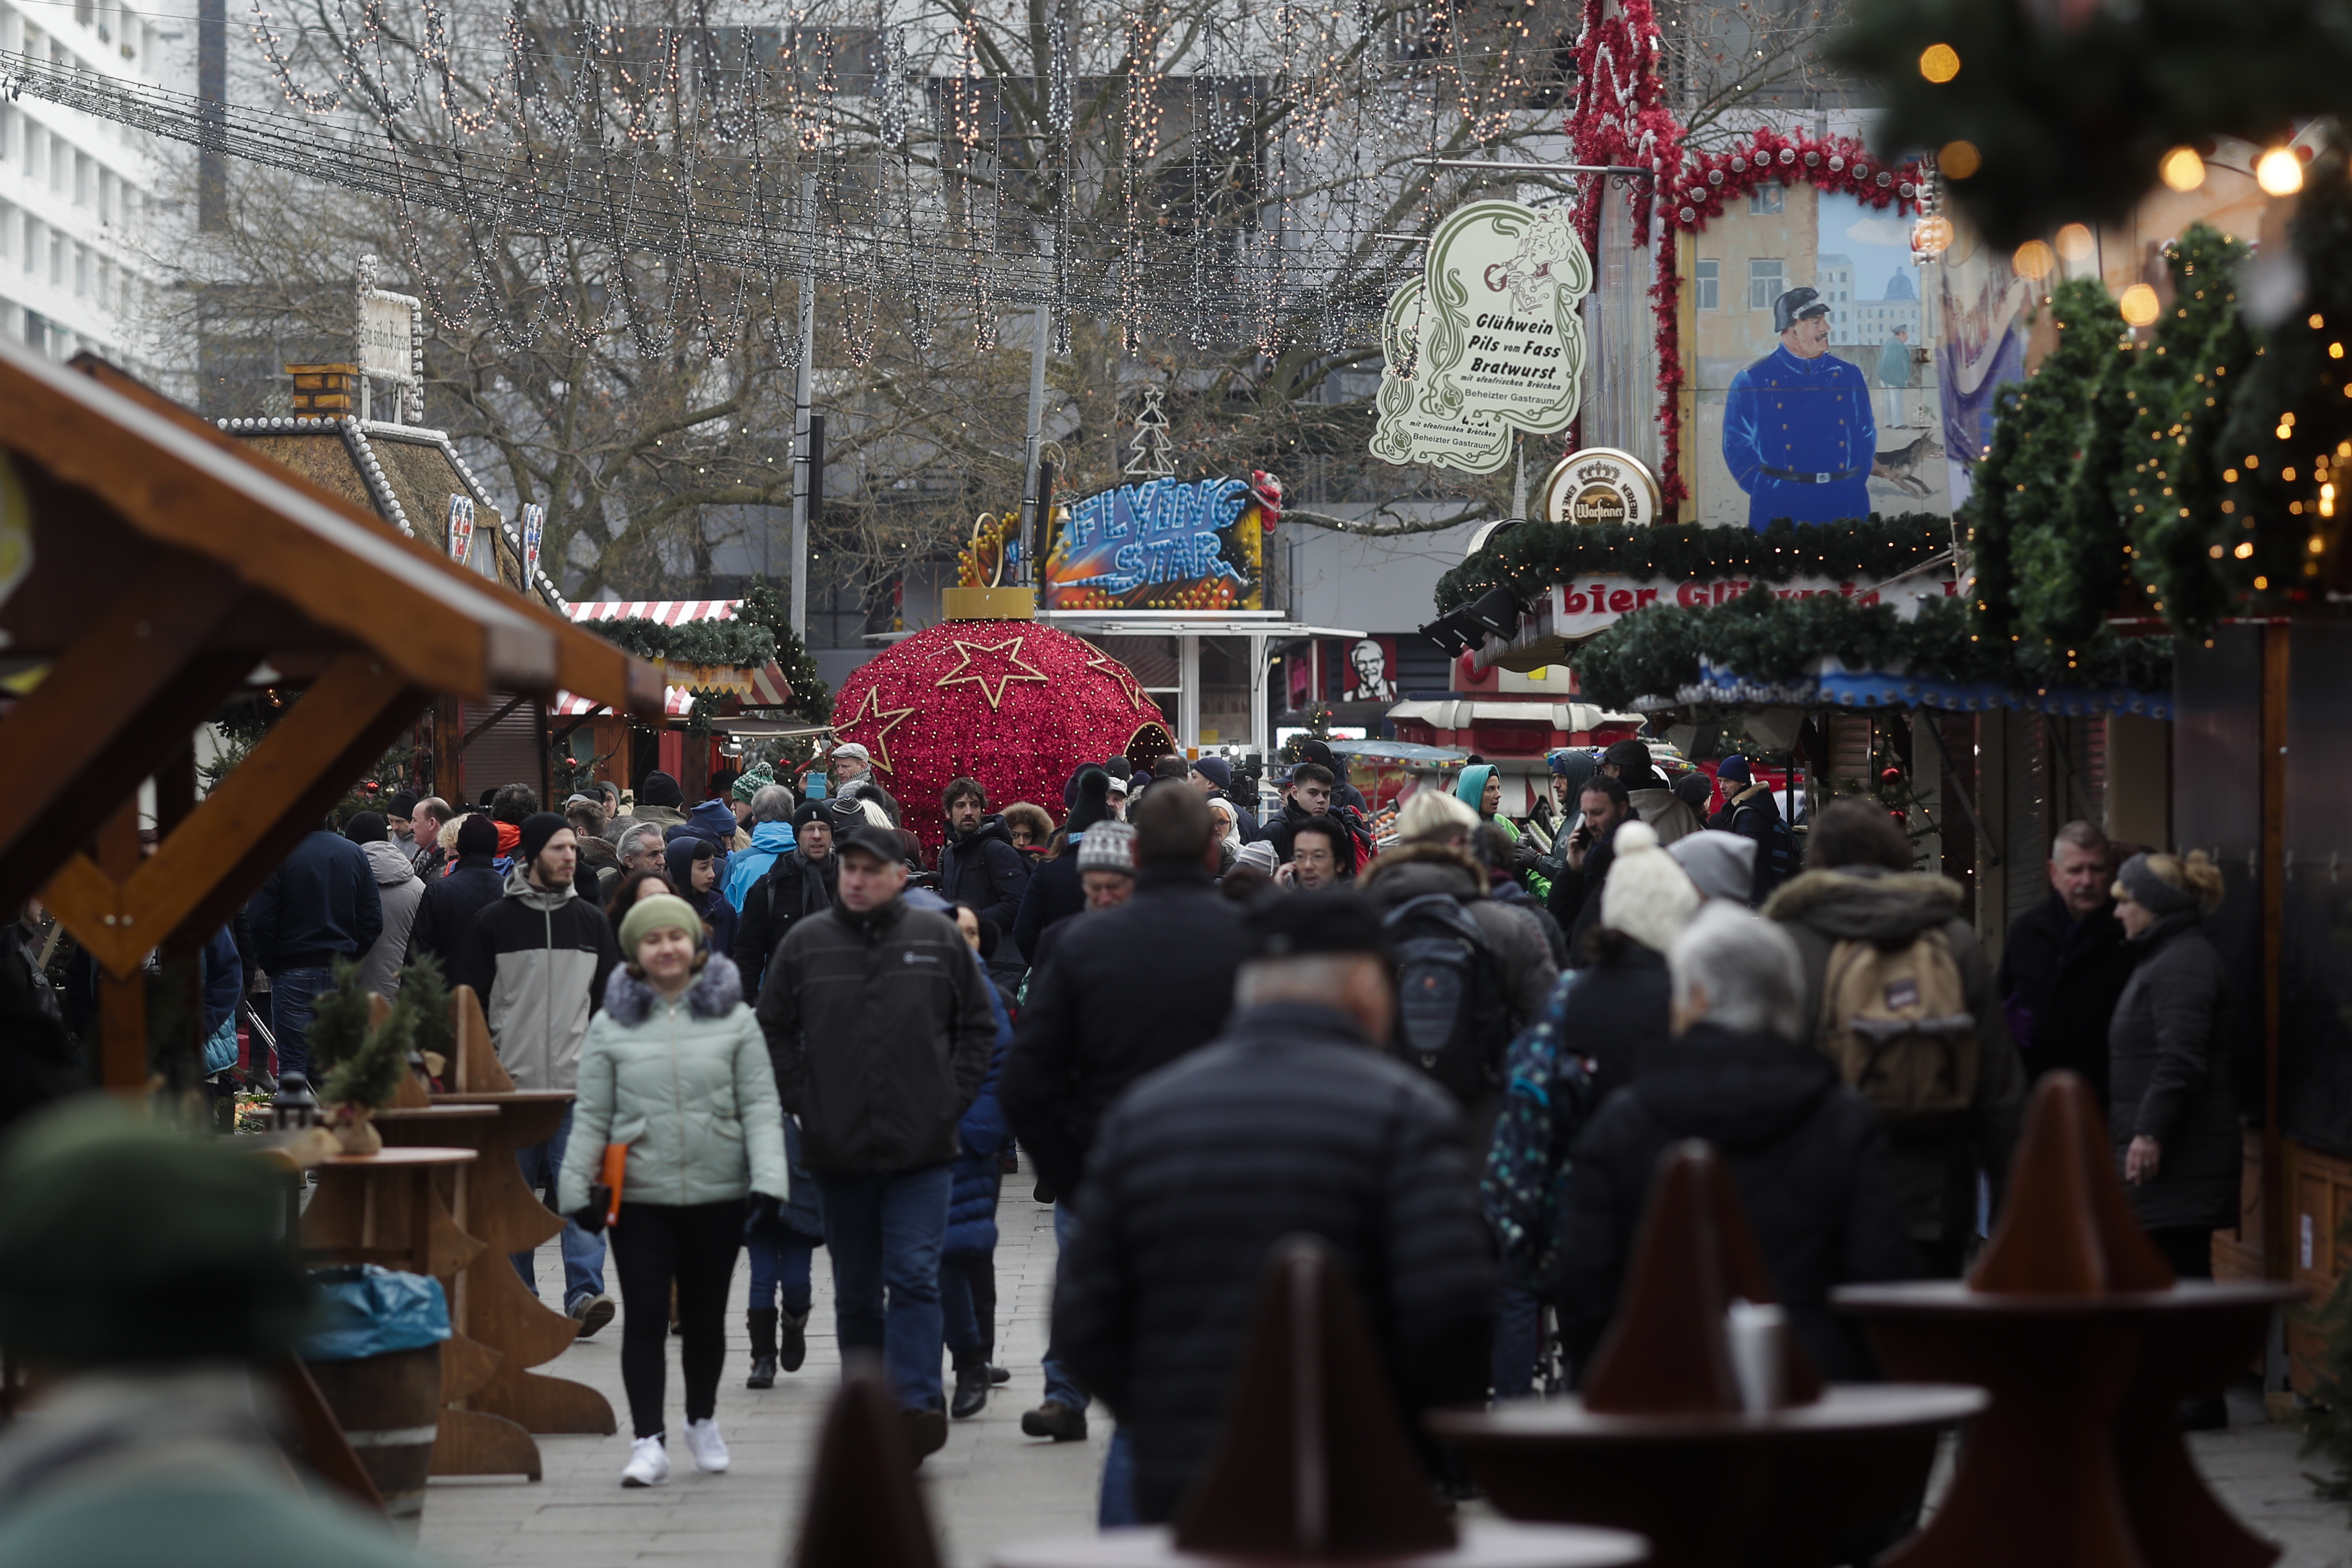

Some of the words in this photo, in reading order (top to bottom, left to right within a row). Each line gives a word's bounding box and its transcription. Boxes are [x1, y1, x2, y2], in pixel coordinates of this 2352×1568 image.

[1476, 313, 1553, 335] Glühwein
[1468, 335, 1500, 352] Pils
[1504, 344, 1521, 353] vom
[1523, 340, 1561, 358] Fass
[1470, 358, 1556, 379] Bratwurst
[1476, 375, 1523, 387] ofenfrischen
[1527, 380, 1561, 391] Brötchen
[1465, 389, 1508, 400] Beheizter
[1510, 393, 1555, 405] Gastraum
[1413, 433, 1450, 444] Beheizter
[1452, 438, 1491, 450] Gastraum
[1423, 422, 1464, 433] ofenfrischen
[1467, 428, 1497, 438] Brötchen
[1562, 484, 1578, 507] EINE
[1620, 483, 1638, 519] BIEREN
[1072, 475, 1250, 548] FLYING
[1576, 498, 1623, 524] Warsteiner
[1108, 531, 1229, 595] STAR
[1563, 583, 1658, 615] bier
